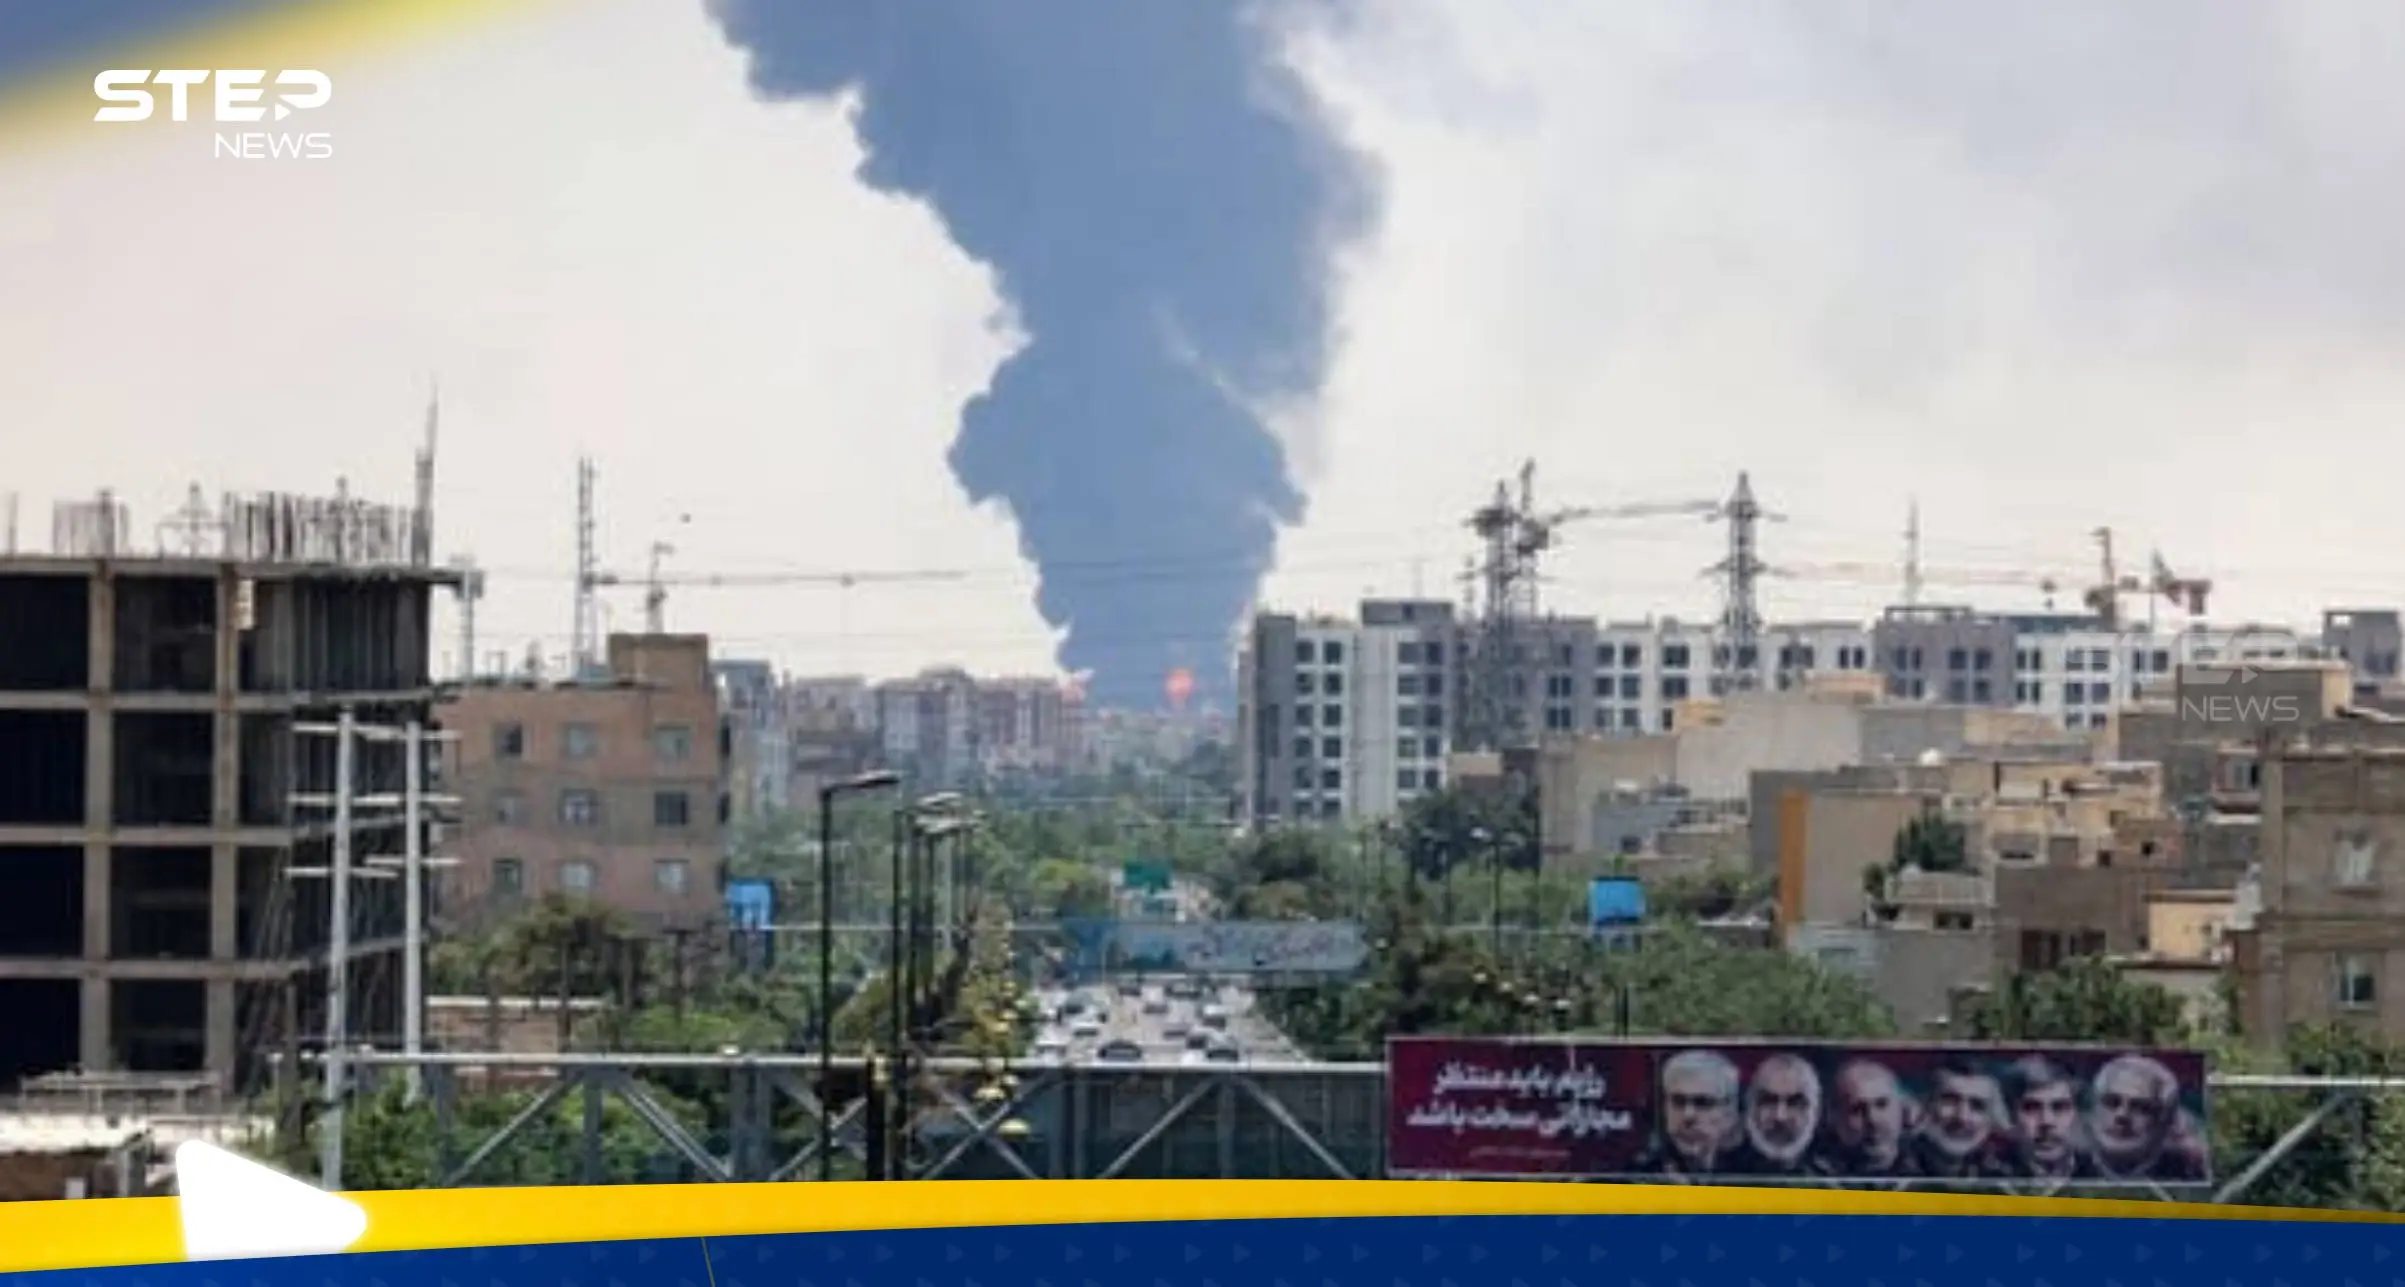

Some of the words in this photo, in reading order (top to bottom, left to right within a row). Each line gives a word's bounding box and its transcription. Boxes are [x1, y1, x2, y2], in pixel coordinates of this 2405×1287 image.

[1432, 1061, 1507, 1095] منتظر
[1508, 1063, 1552, 1098] باید
[1406, 1100, 1466, 1135] باشد
[1467, 1100, 1538, 1130] سخت
